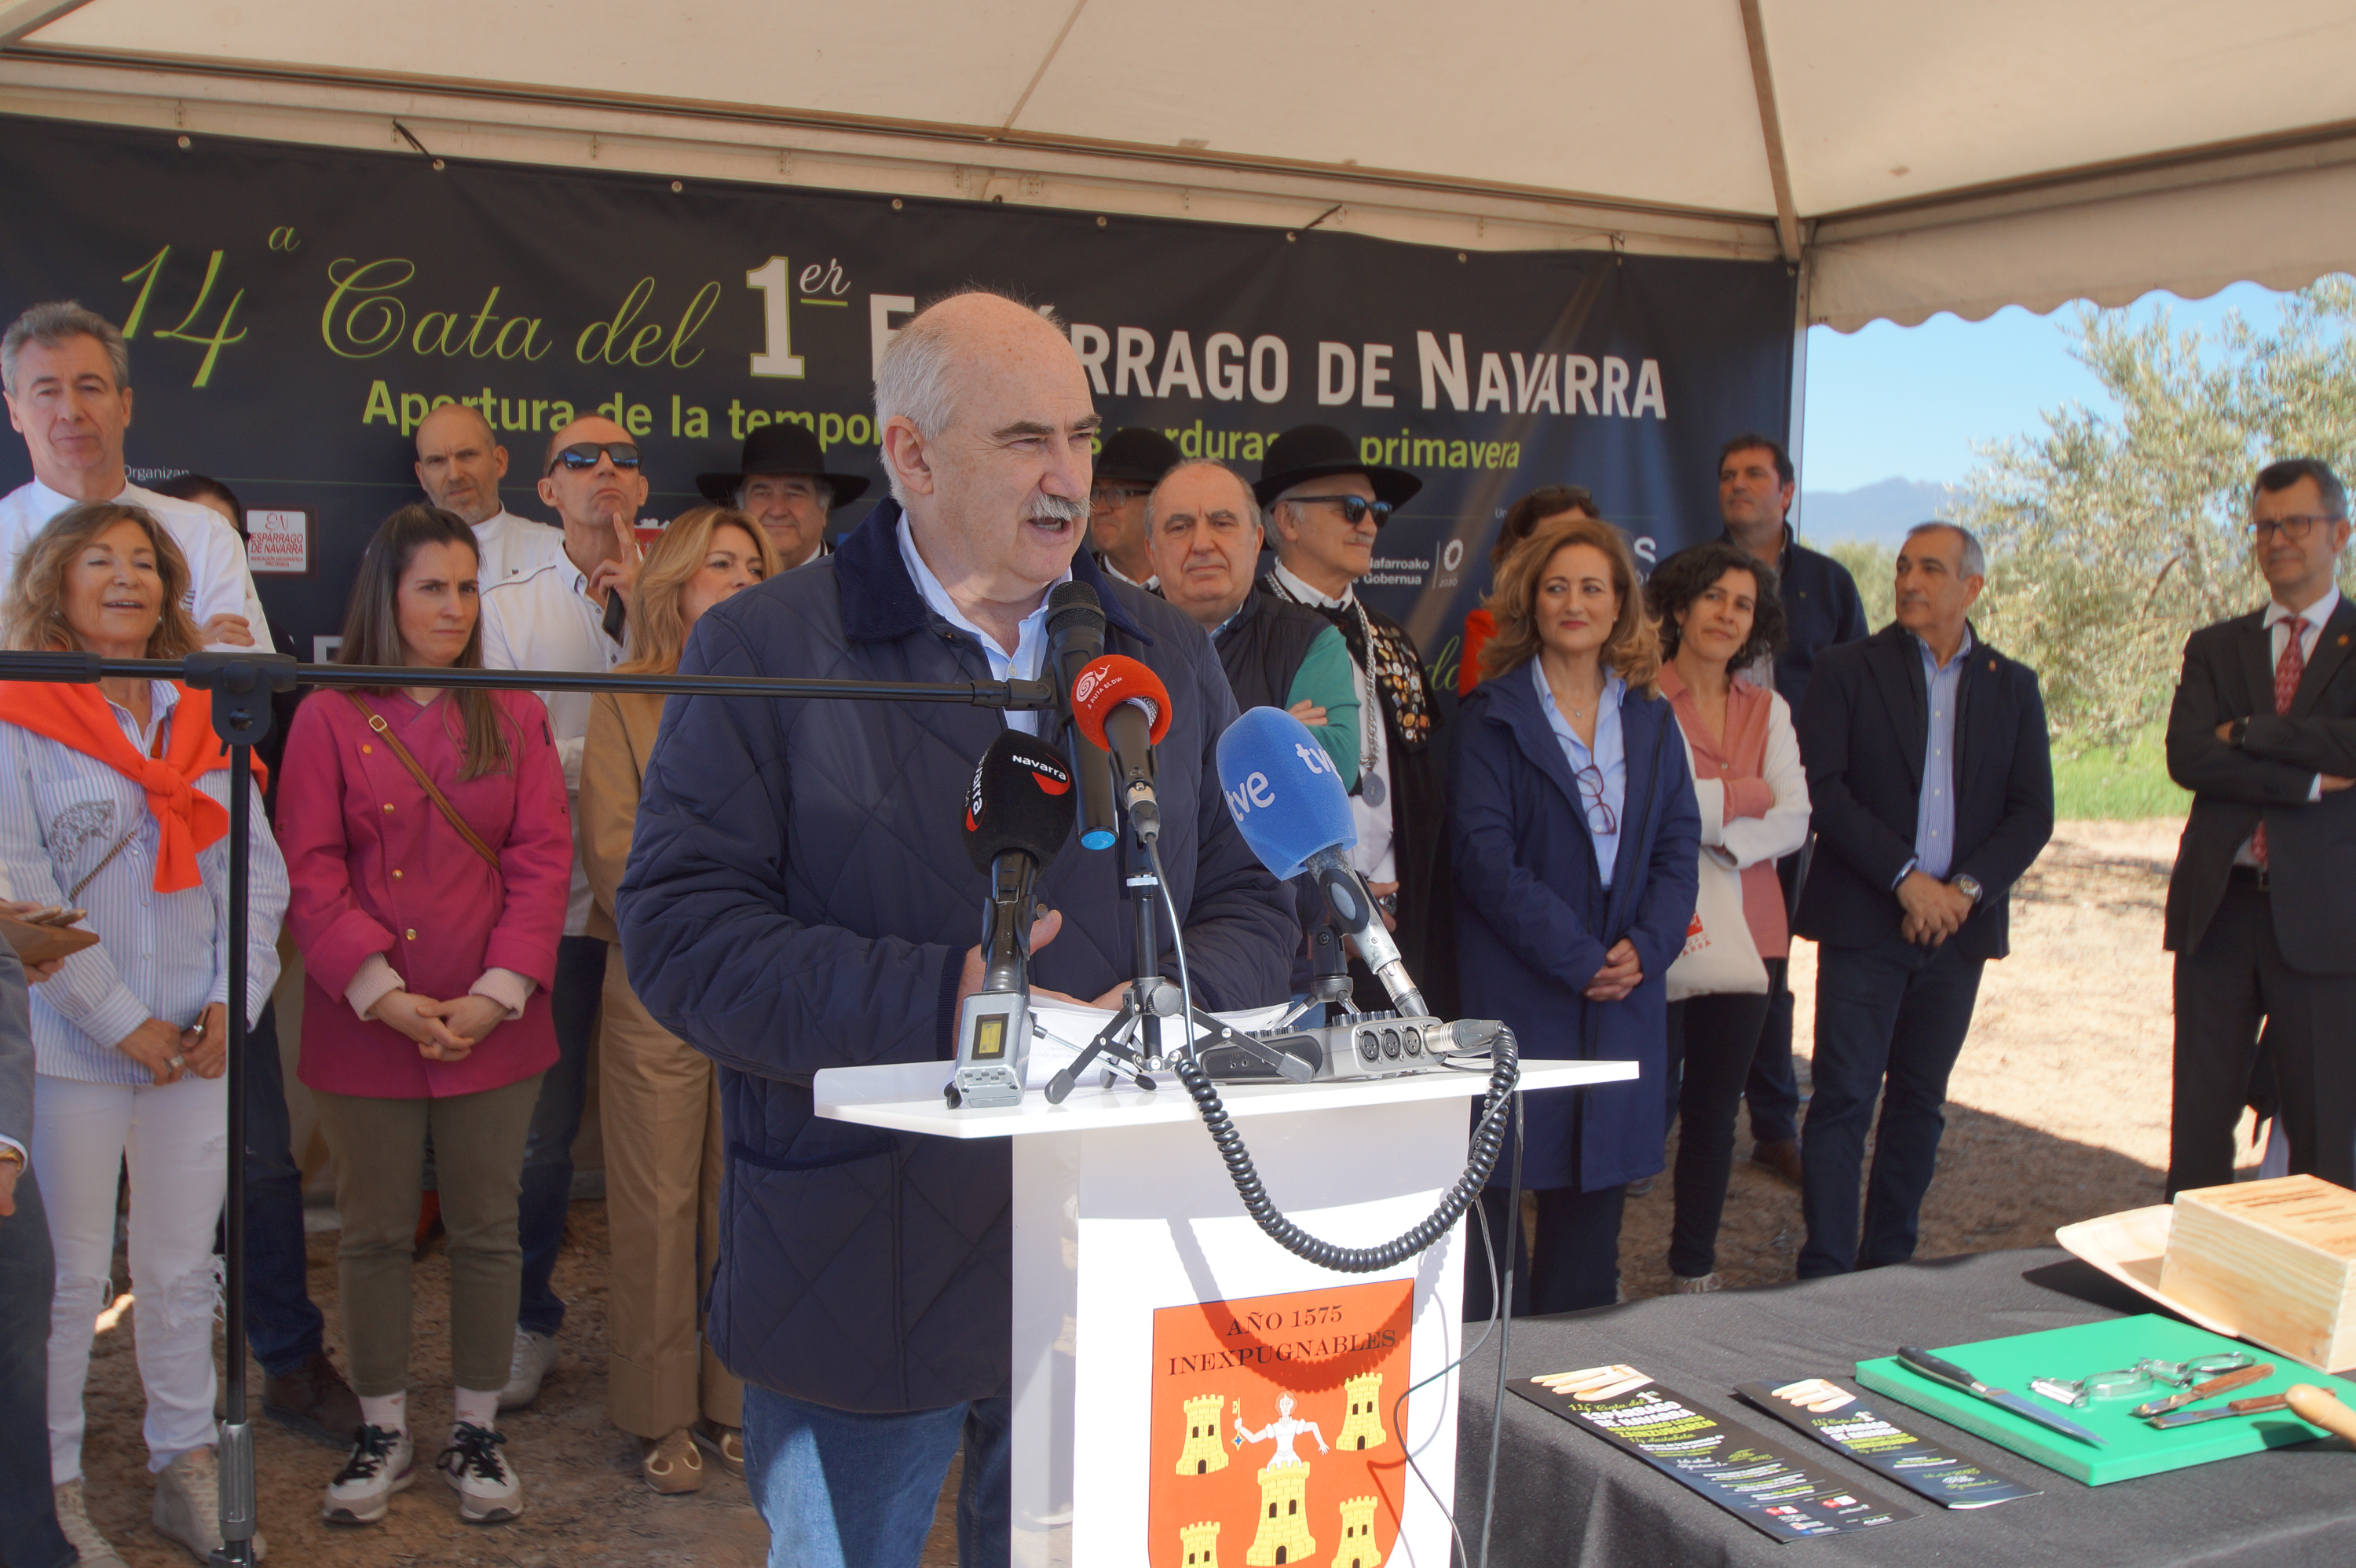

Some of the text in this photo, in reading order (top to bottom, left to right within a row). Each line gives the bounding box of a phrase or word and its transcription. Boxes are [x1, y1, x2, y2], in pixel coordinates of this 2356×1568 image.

[322, 258, 552, 361] Cata
[576, 276, 720, 368] del
[1318, 341, 1395, 408] DE
[672, 395, 708, 438] la
[1360, 428, 1520, 469] primavera
[251, 543, 304, 554] DE NAVARRA
[1363, 572, 1421, 585] Gobernua
[1012, 755, 1066, 780] Navarra
[1225, 771, 1275, 822] tve
[1227, 1304, 1342, 1336] AÑO 1575
[1169, 1330, 1396, 1376] INEXPUGNABLES
